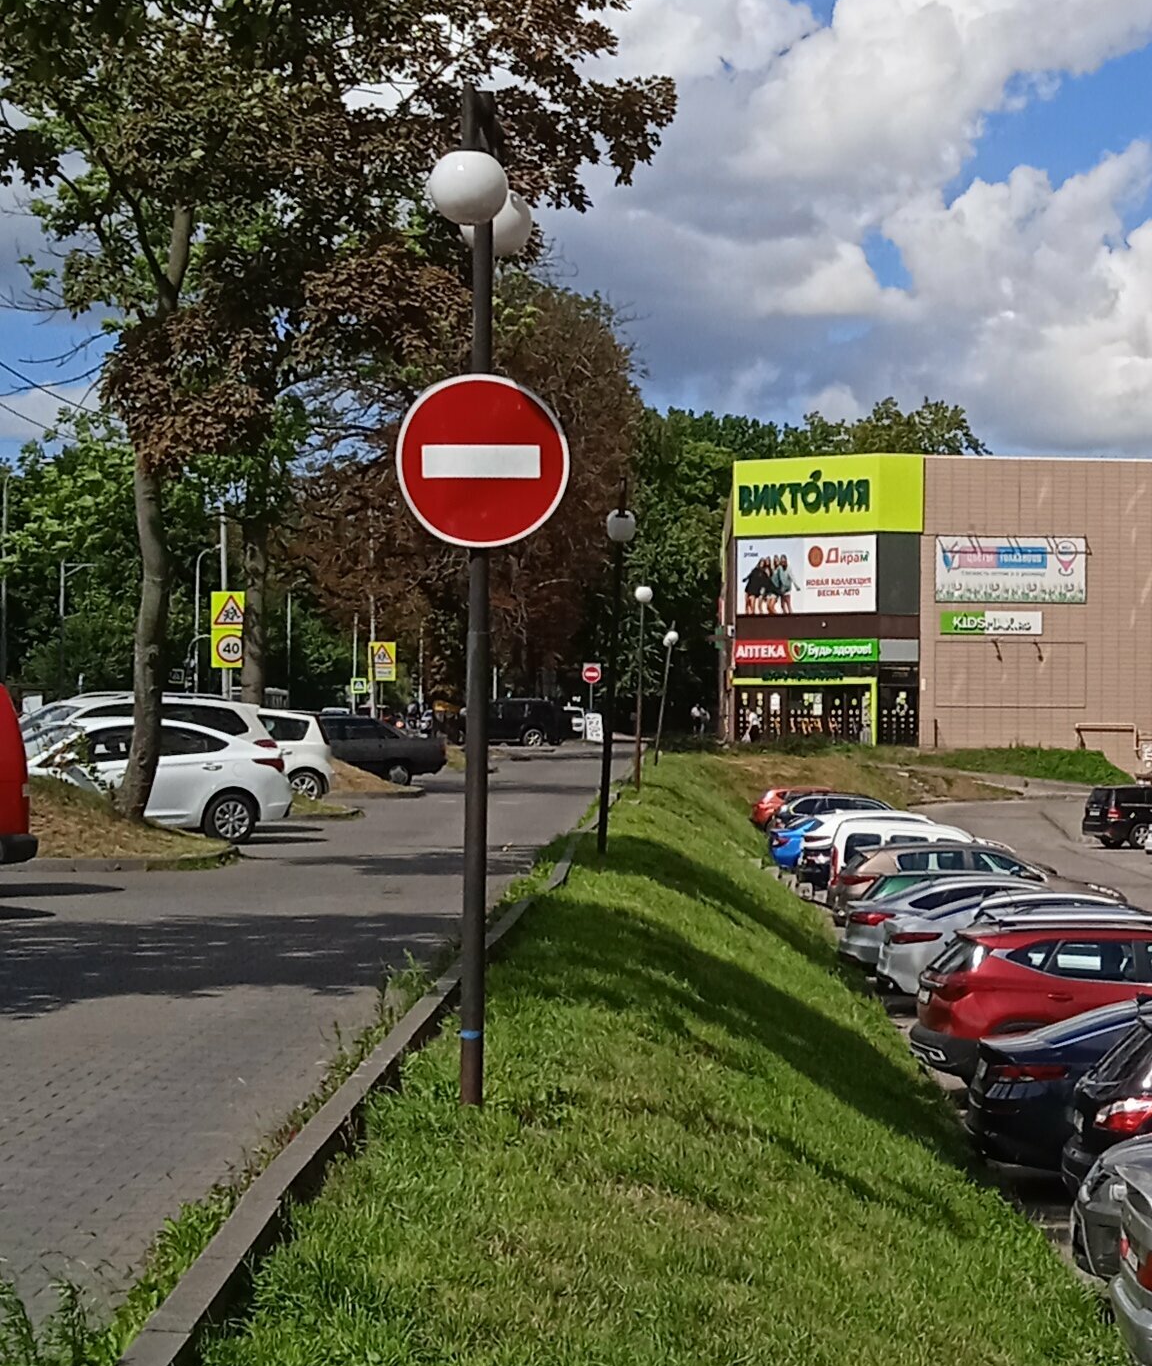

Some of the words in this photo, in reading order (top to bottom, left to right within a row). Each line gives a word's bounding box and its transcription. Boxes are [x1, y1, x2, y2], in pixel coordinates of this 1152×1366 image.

[738, 478, 870, 517] ВИКТОРИЯ
[223, 642, 239, 654] 40
[735, 644, 786, 659] АПТЕКА
[807, 643, 832, 659] Будь
